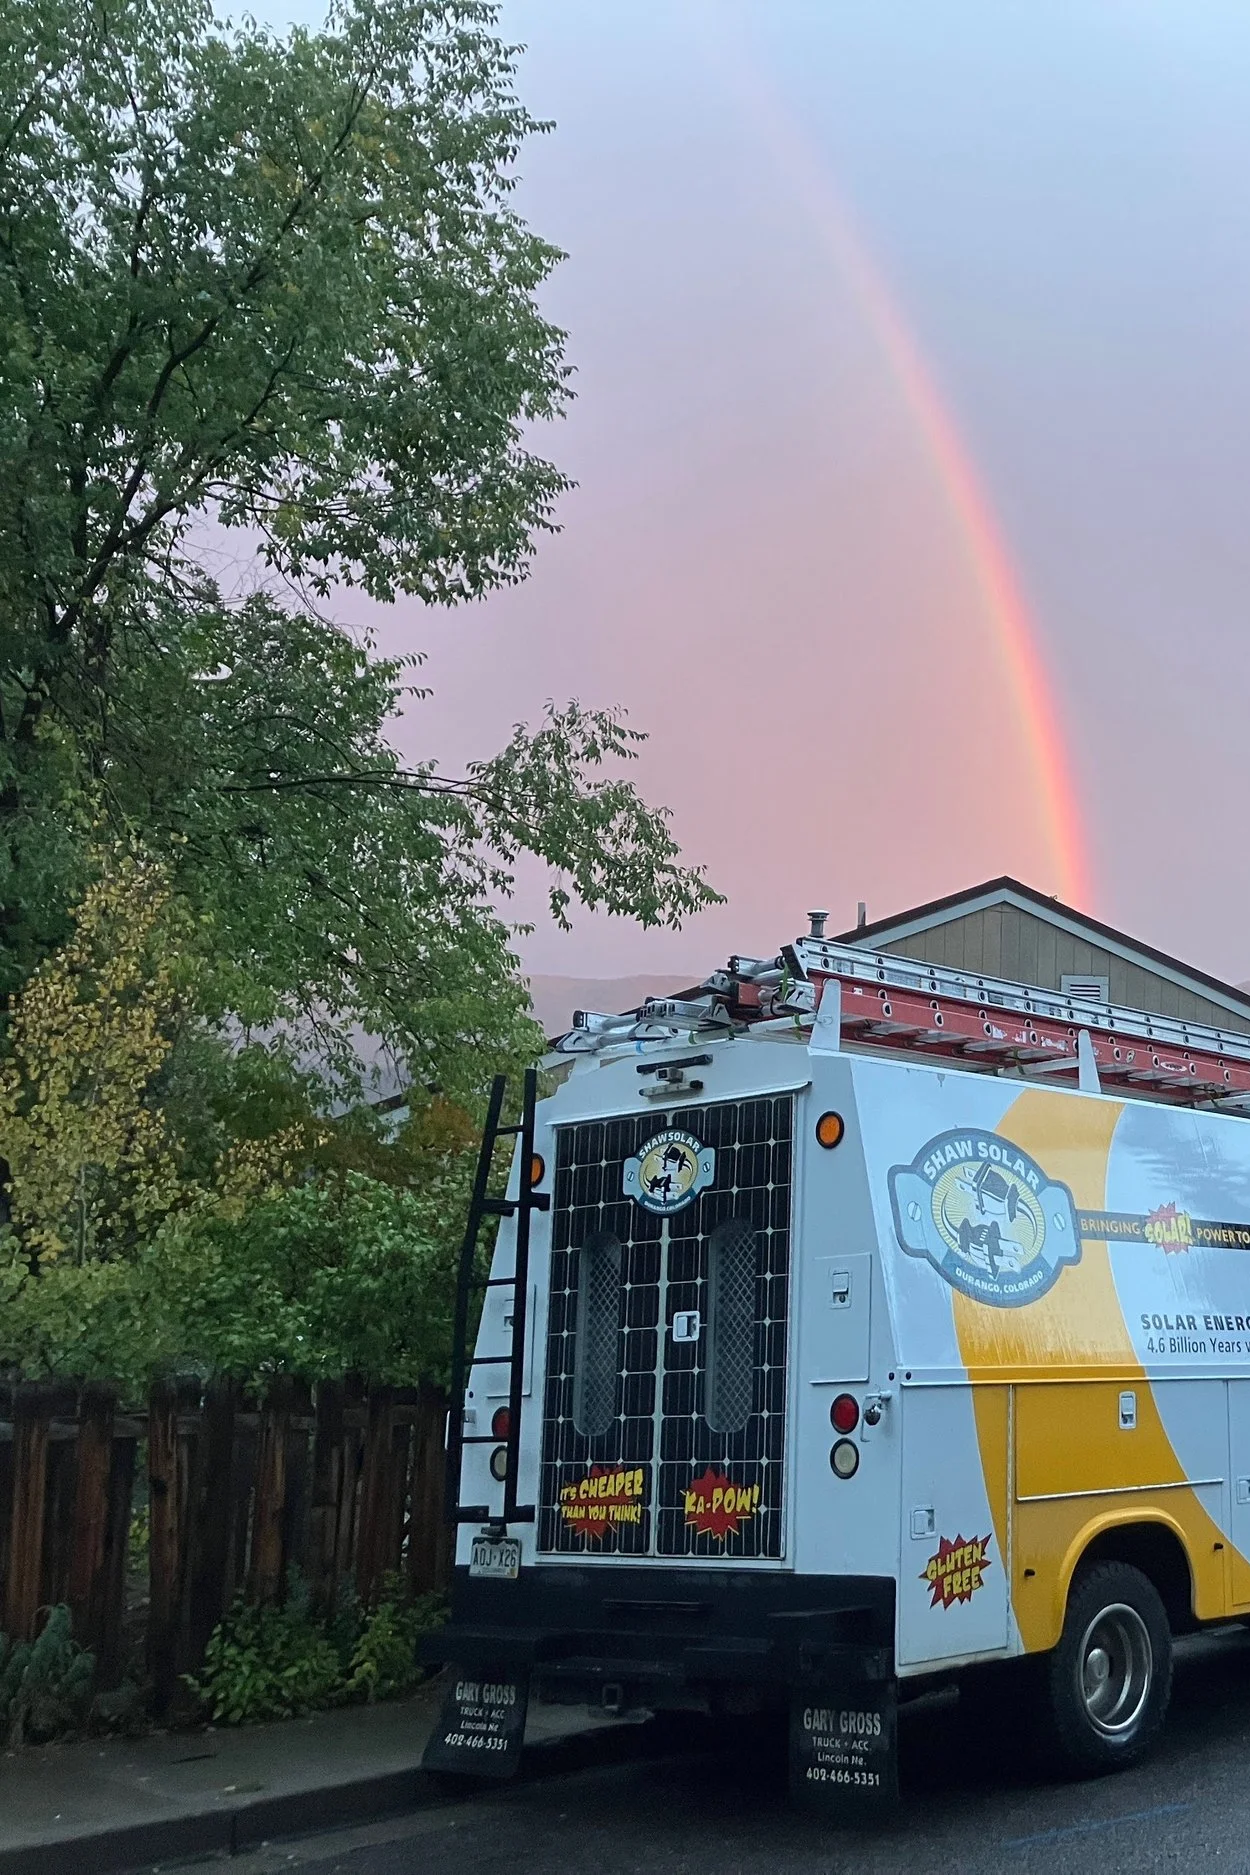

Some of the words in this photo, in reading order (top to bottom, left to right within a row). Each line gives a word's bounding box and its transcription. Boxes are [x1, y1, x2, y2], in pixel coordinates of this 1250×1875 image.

[639, 1133, 667, 1159] SHAW
[668, 1132, 701, 1153] SOLAR
[923, 1139, 973, 1181] SHAW
[977, 1141, 1040, 1190] SOLAR
[1080, 1218, 1140, 1235] BRINGING
[1144, 1209, 1193, 1245] SOLAR!
[1196, 1227, 1235, 1243] POWER
[1234, 1230, 1250, 1245] TO
[955, 1267, 1002, 1294] DURANGO,
[1003, 1270, 1044, 1294] COLORADO
[1141, 1313, 1197, 1331] SOLAR
[1147, 1337, 1165, 1354] 4.6
[1169, 1337, 1207, 1354] Billion
[1209, 1338, 1242, 1354] Years
[560, 1485, 577, 1501] IT'S
[579, 1468, 643, 1500] CHEAPER
[684, 1484, 761, 1514] KA-POW!
[561, 1505, 586, 1519] THAN
[588, 1504, 607, 1521] YOU
[608, 1502, 642, 1525] THINK!
[926, 1542, 983, 1581] GLUTEN
[942, 1565, 981, 1599] FREE
[455, 1681, 480, 1703] GARY
[482, 1683, 516, 1706] GROSS
[460, 1706, 483, 1717] TRUCK
[803, 1707, 835, 1733] GARY
[840, 1710, 881, 1736] GROSS
[812, 1736, 841, 1749] TRUCK
[817, 1752, 849, 1764] Lincoln
[806, 1767, 880, 1787] 402-466-5351
